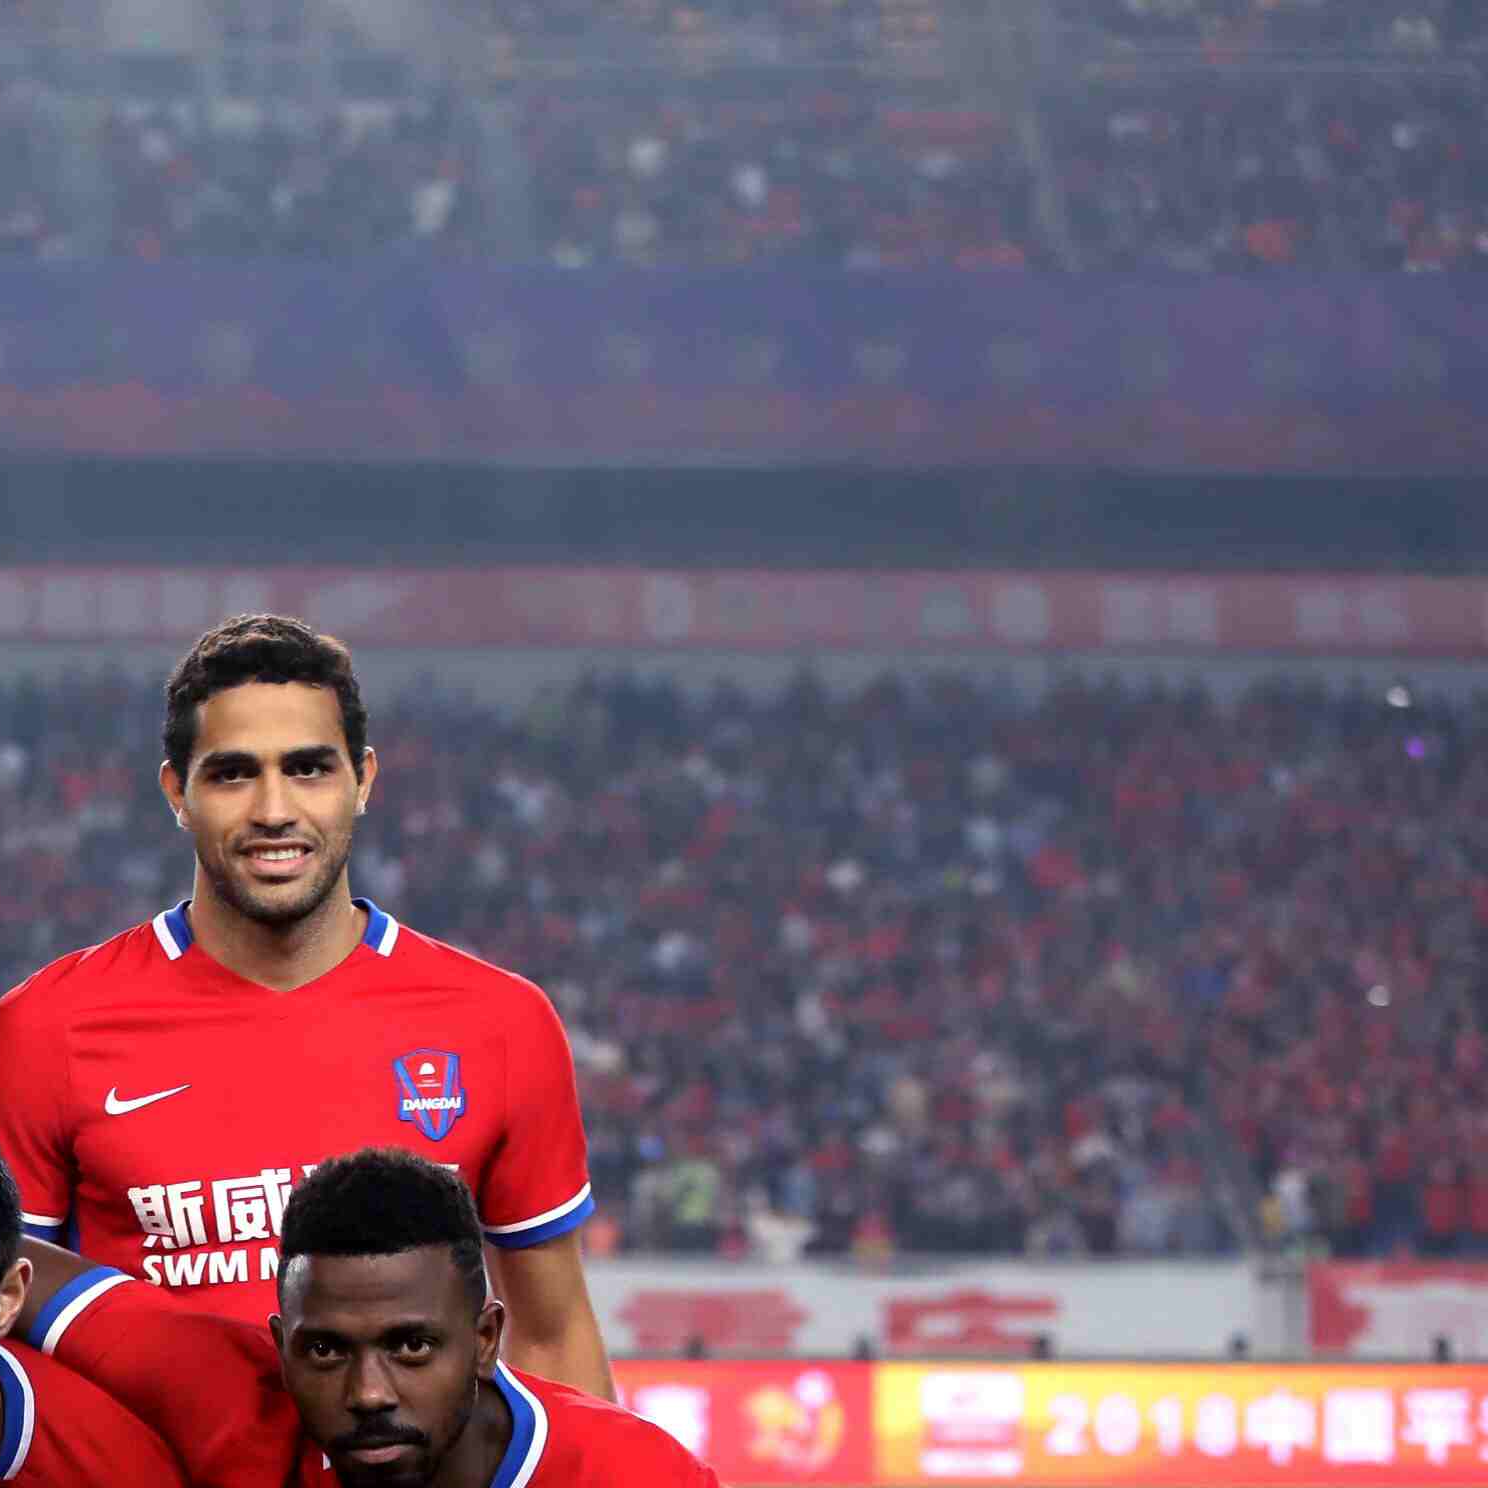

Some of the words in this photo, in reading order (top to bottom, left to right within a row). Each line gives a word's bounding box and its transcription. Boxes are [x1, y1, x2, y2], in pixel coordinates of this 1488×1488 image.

[141, 1249, 249, 1288] SWM
[1047, 1387, 1488, 1466] 2018中国平
